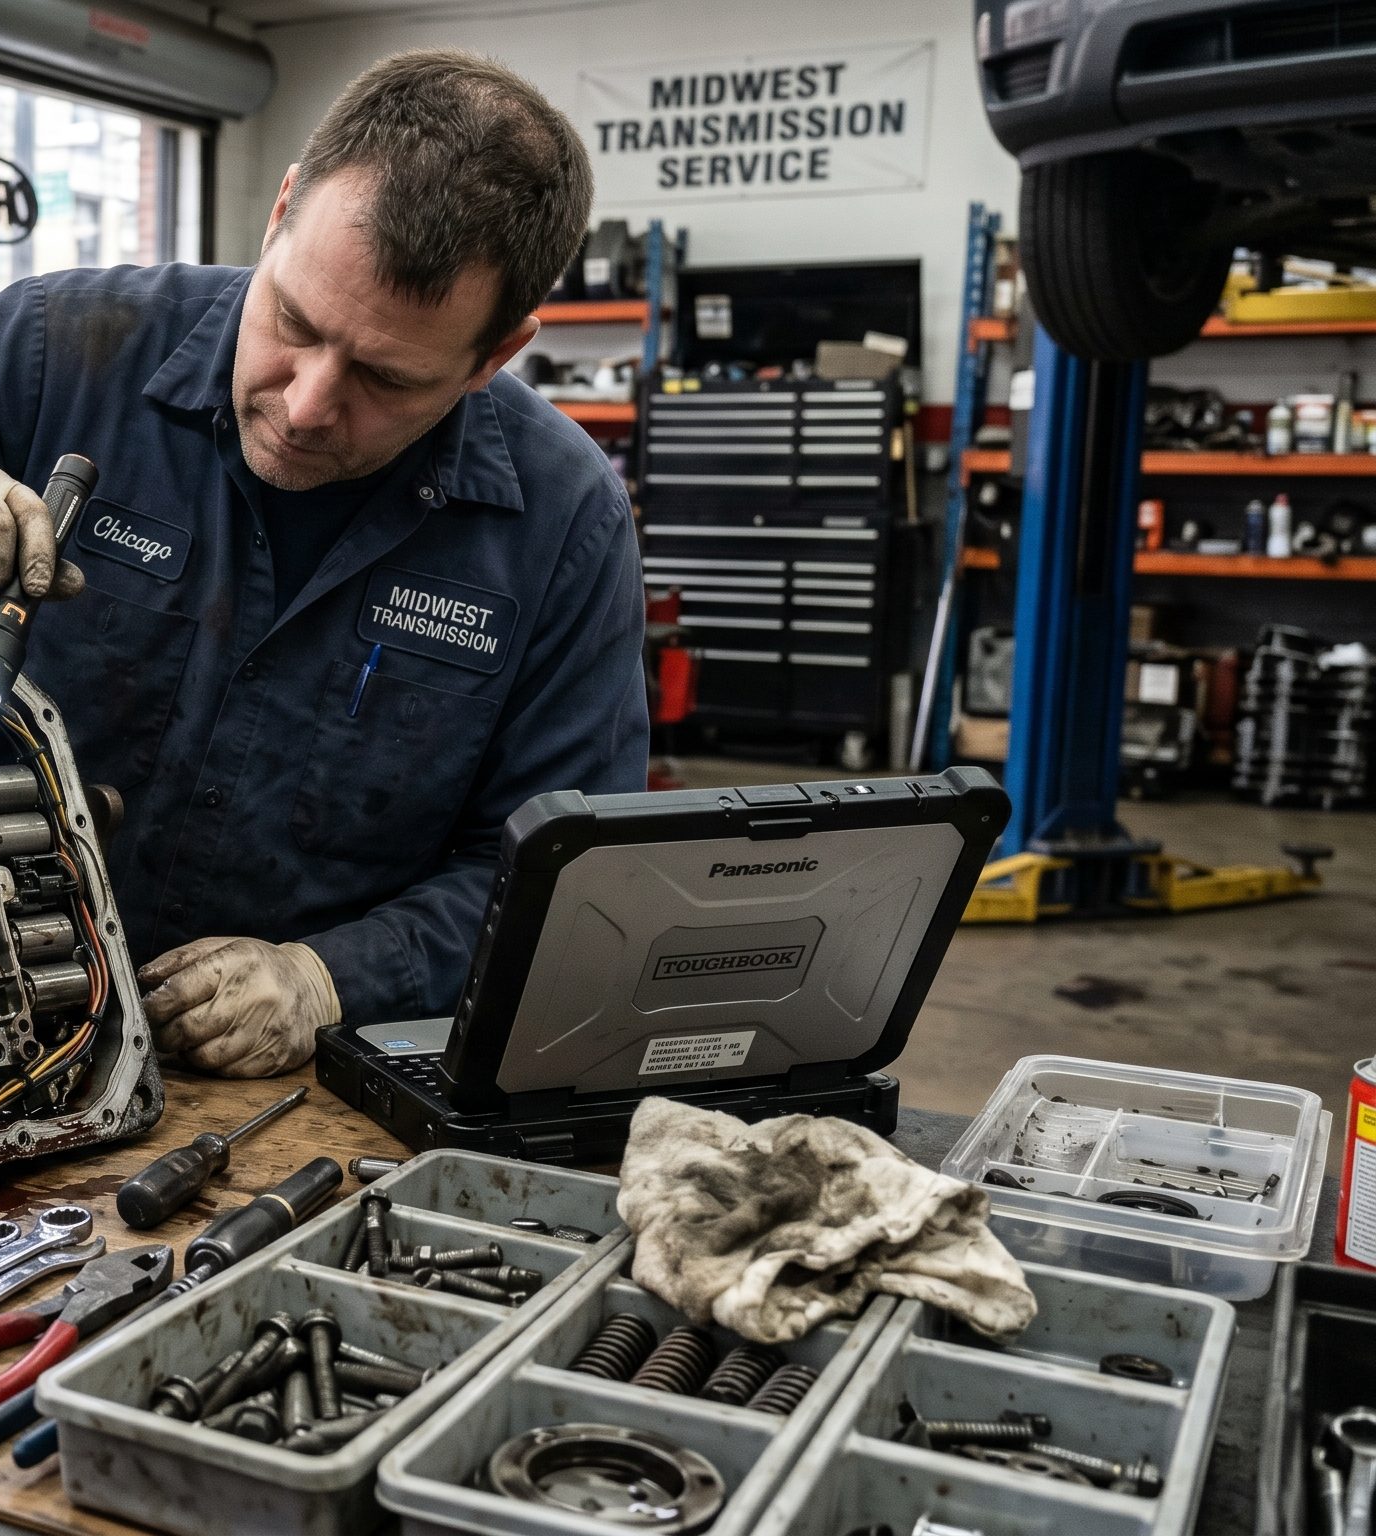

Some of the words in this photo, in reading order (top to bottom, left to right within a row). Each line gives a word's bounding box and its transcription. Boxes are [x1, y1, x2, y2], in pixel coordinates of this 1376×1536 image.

[650, 62, 846, 110] MIDWEST
[596, 101, 905, 153] TRANSMISSION
[658, 148, 830, 189] SERVICE
[93, 515, 172, 563] Chicago
[372, 605, 498, 655] TRANSMISSION
[389, 586, 494, 630] MIDWEST
[708, 856, 819, 879] Panasonic
[662, 951, 797, 975] TOUGHBOOK
